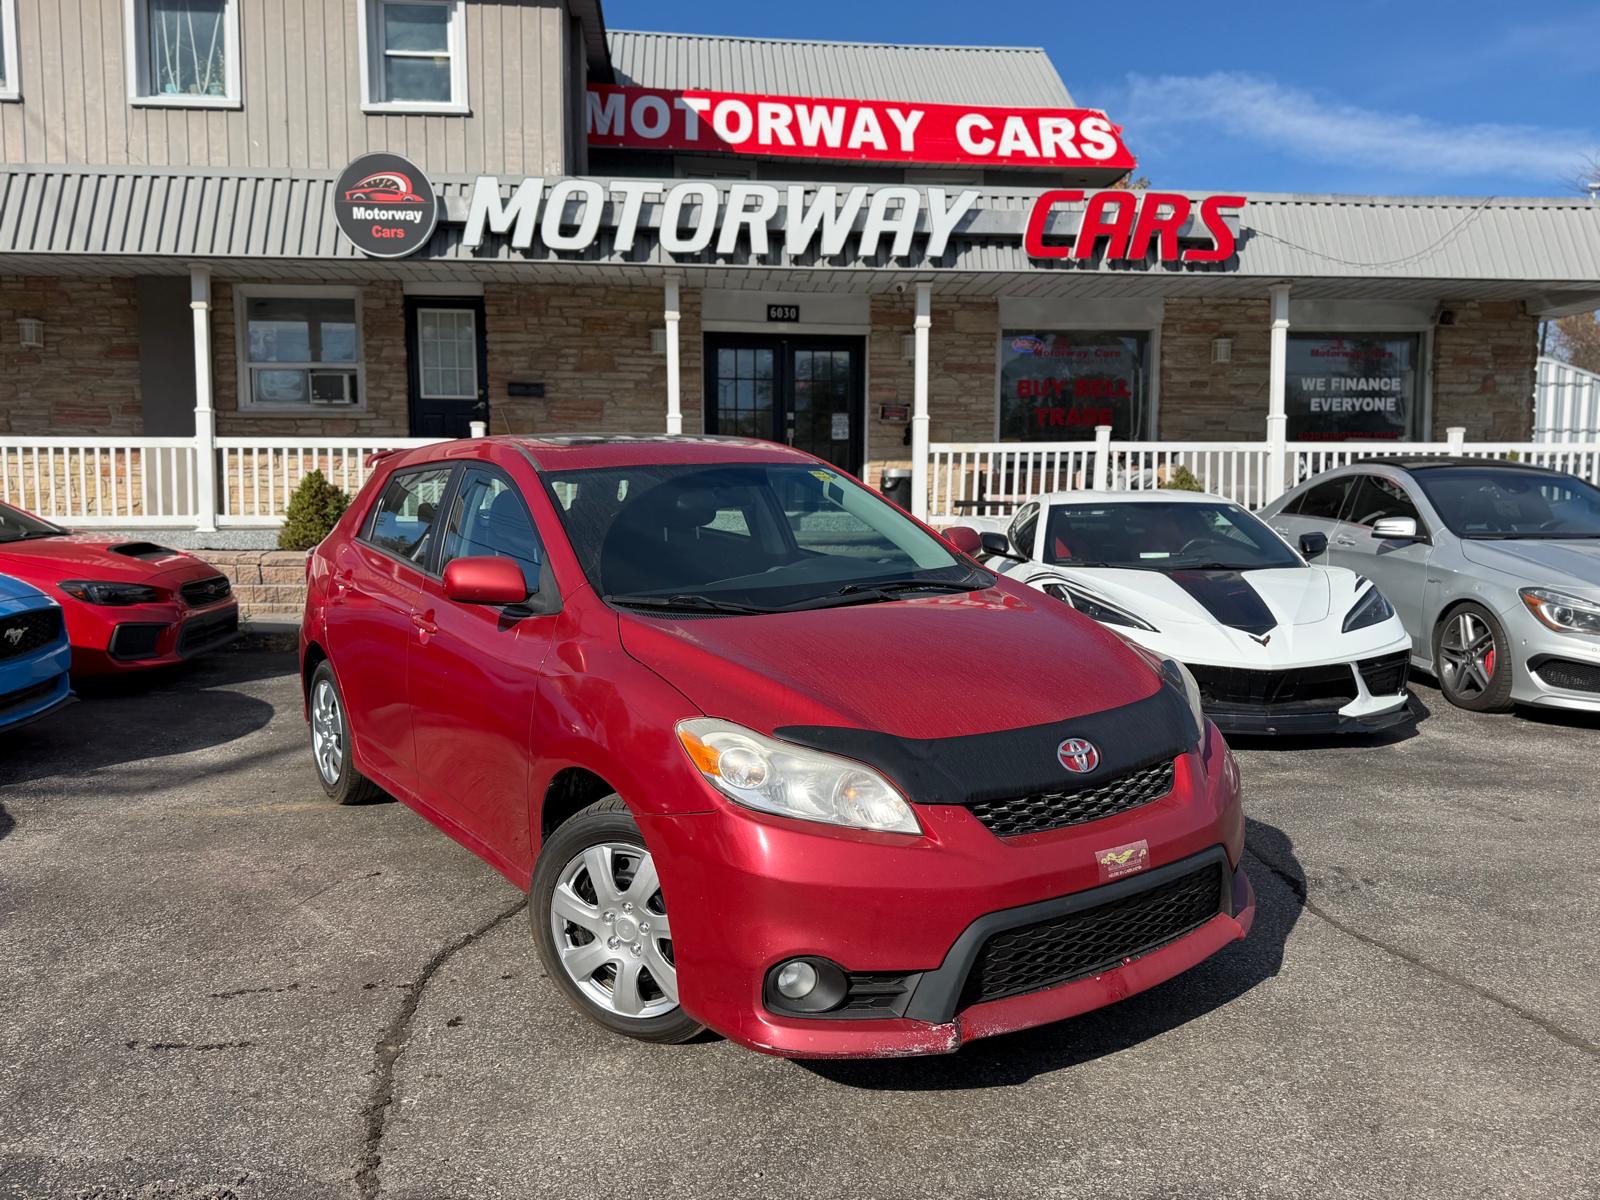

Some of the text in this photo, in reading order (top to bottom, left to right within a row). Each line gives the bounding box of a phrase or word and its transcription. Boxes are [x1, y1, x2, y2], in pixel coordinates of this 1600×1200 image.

[586, 91, 1118, 161] MOTORWAY CARS
[352, 207, 423, 223] Motorway
[462, 176, 1247, 261] MOTORWAY CARS
[371, 225, 405, 238] Cars
[770, 307, 797, 319] 6030
[1017, 378, 1067, 398] BUY
[1302, 377, 1401, 391] WE FINANCE
[1310, 398, 1396, 412] EVERYONE
[1034, 407, 1114, 426] TRADE
